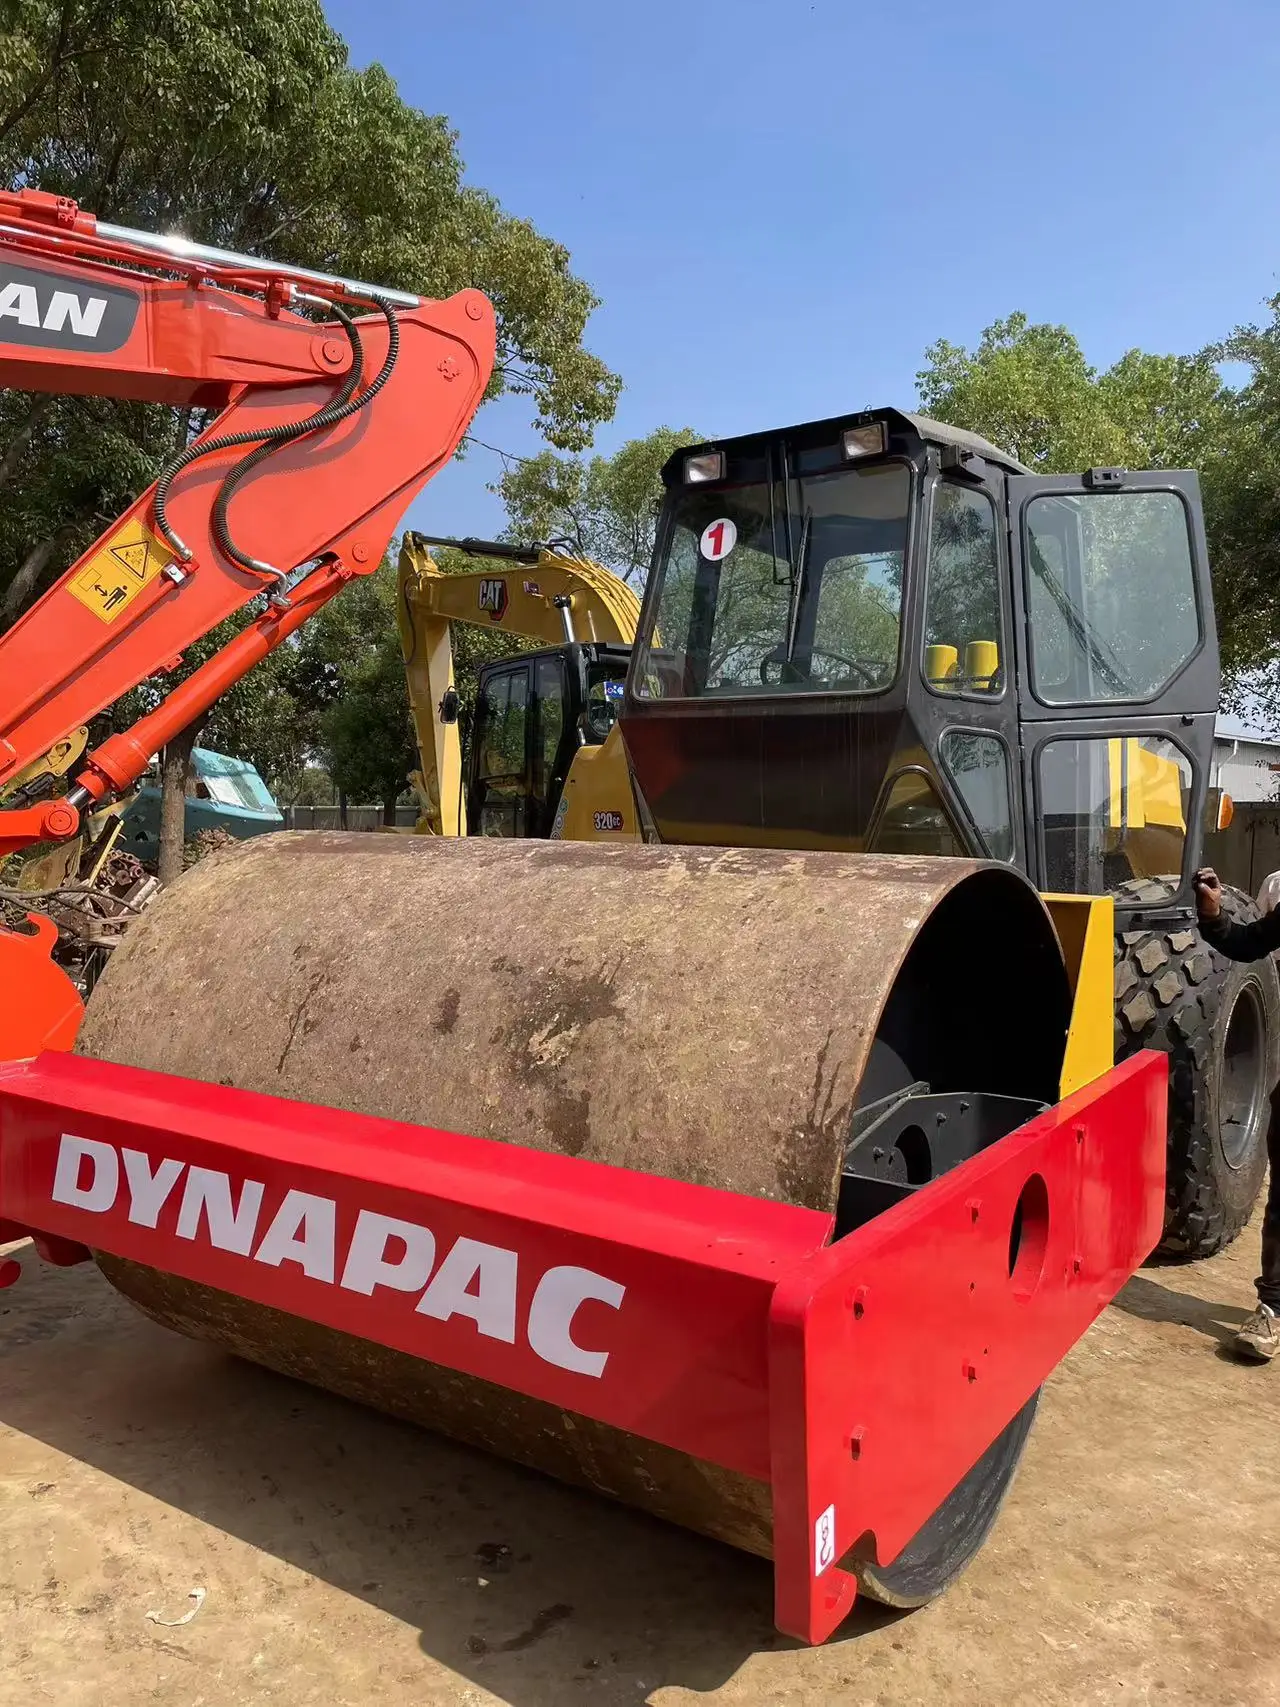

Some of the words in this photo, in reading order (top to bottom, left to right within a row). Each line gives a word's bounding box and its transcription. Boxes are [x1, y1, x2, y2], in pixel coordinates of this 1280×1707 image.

[0, 282, 108, 338] AN
[708, 522, 724, 556] 1
[479, 580, 502, 610] CAT
[52, 1133, 626, 1378] DYNAPAC
